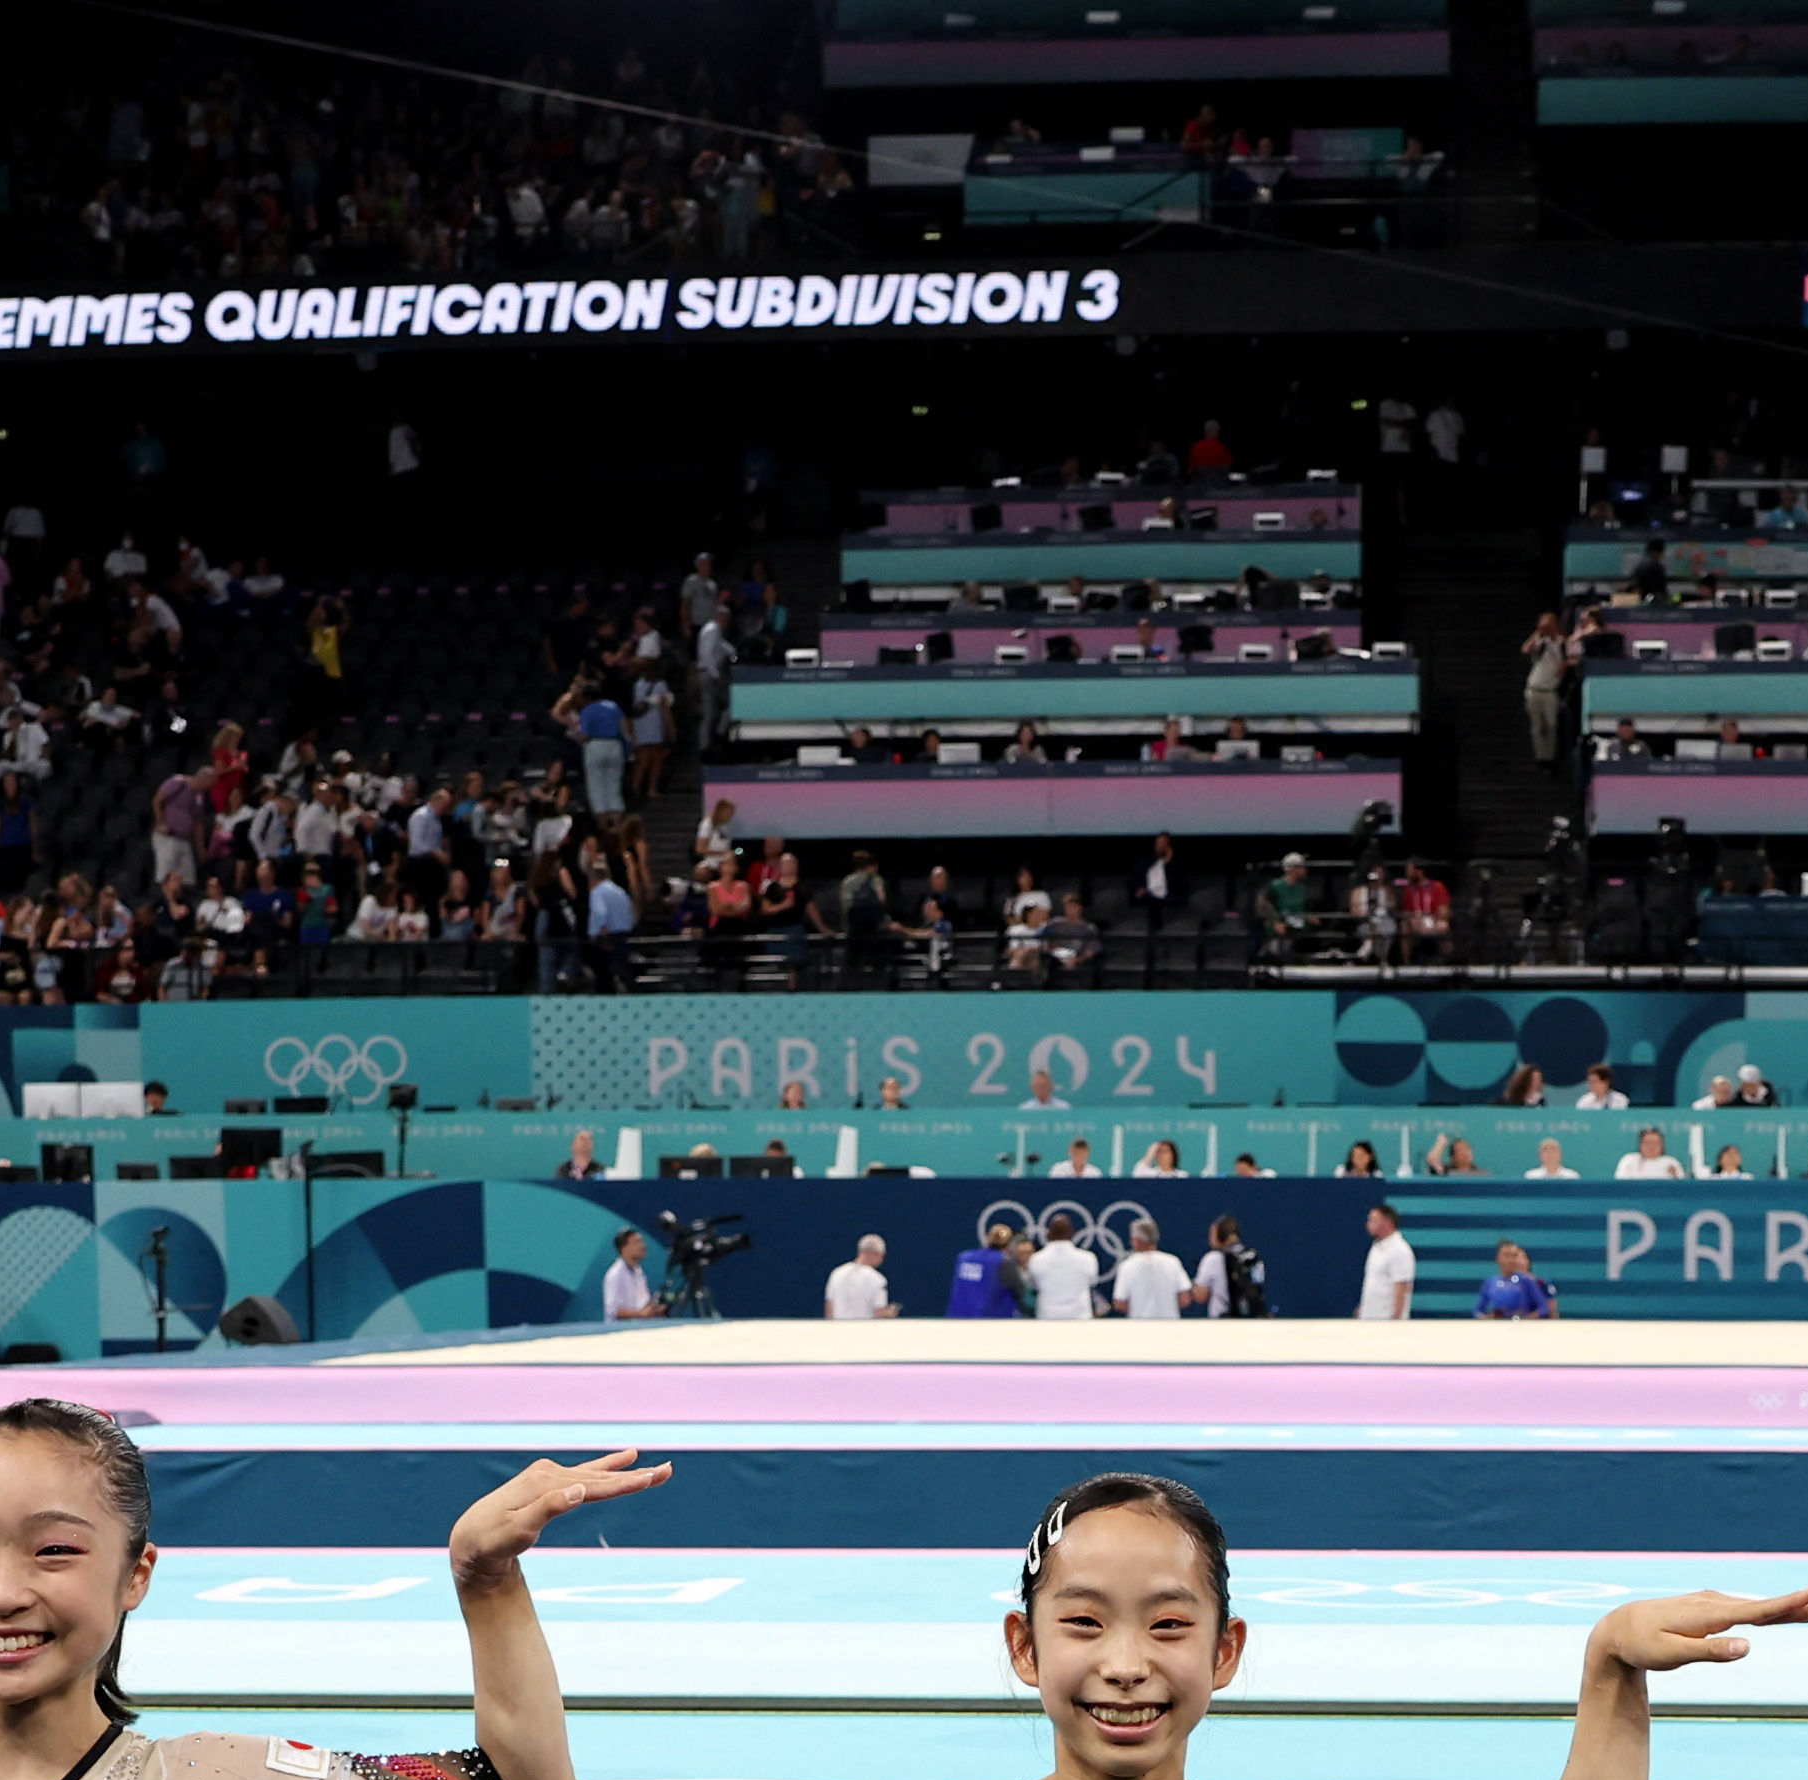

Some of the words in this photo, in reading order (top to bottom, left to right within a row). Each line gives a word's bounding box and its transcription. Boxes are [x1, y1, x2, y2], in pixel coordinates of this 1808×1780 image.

[205, 279, 668, 341] QUALIFICATION
[676, 270, 1069, 329] SUBDIVISION
[1076, 269, 1120, 321] 3
[647, 1034, 922, 1098] PARIS
[966, 1031, 1218, 1103] 2024
